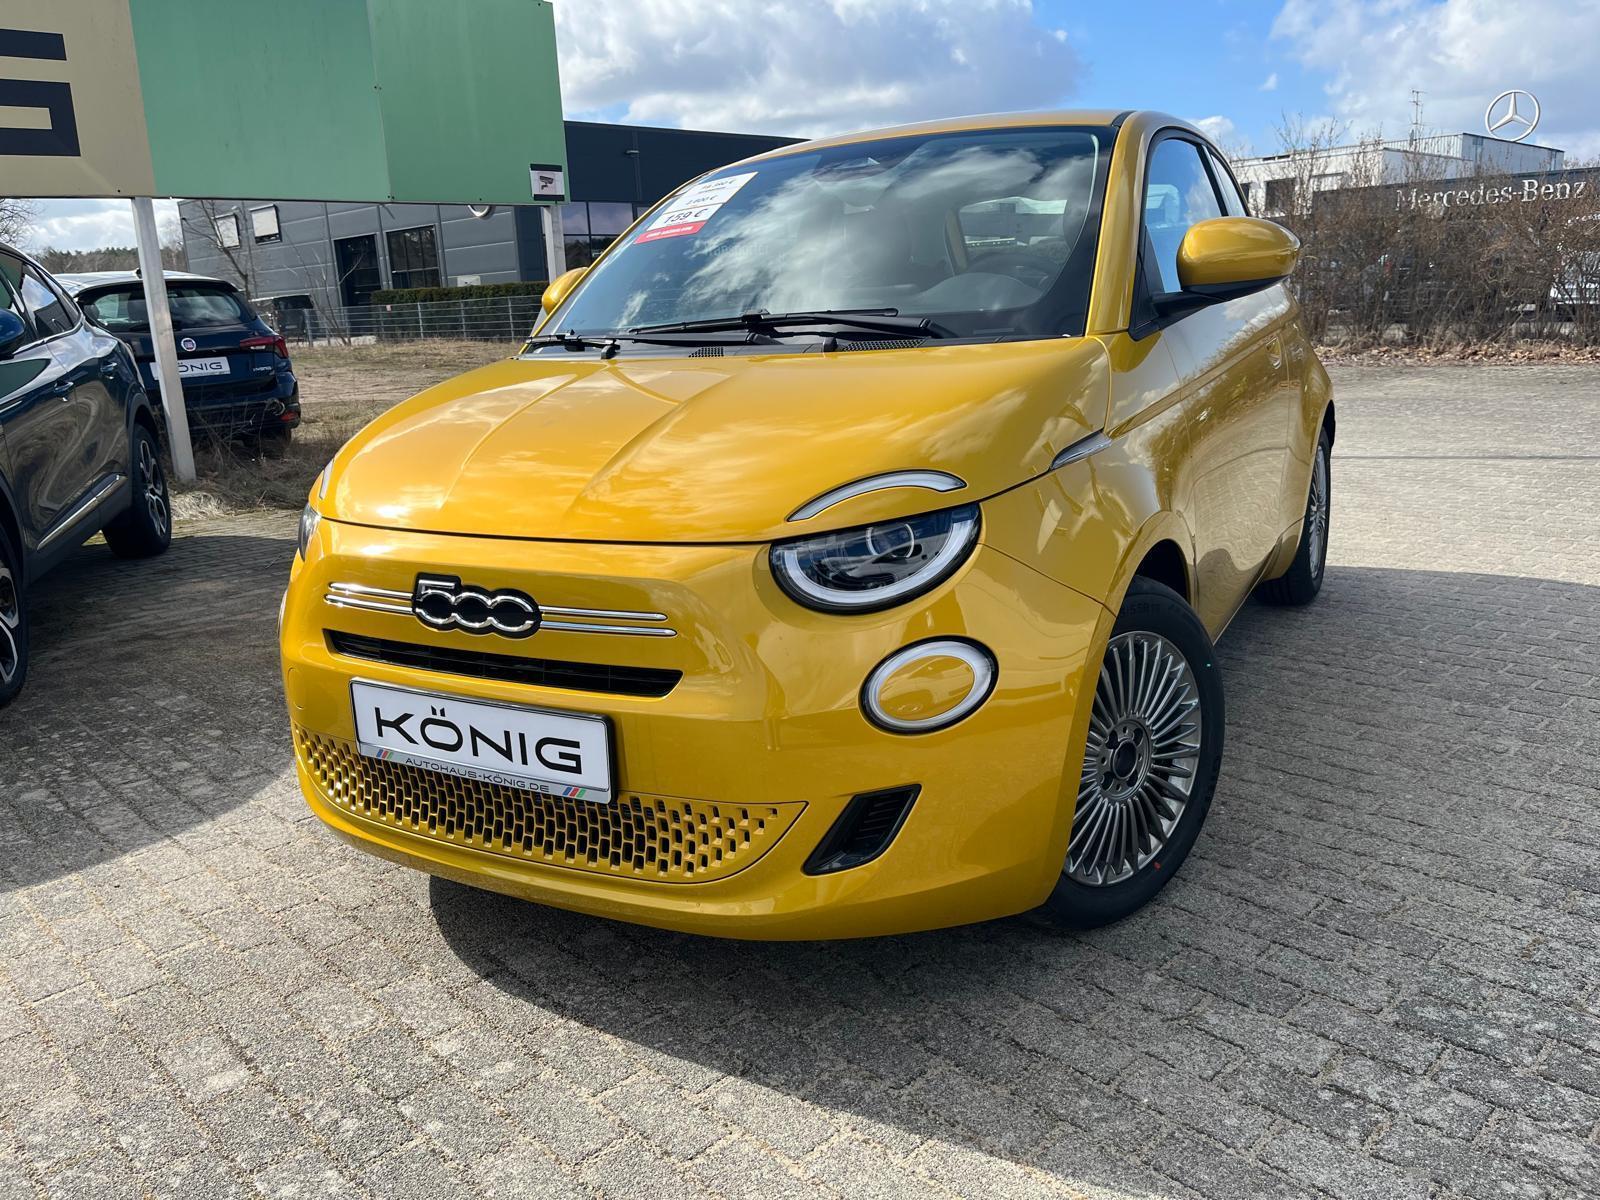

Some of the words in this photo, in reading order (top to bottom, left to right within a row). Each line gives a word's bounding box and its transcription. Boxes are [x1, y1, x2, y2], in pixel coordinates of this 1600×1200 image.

[1395, 179, 1587, 211] Mercedes-Benz
[663, 211, 692, 224] 159
[177, 361, 223, 373] ÖNIG
[413, 575, 539, 635] 500
[373, 704, 583, 775] KÖNIG
[404, 756, 550, 793] AUTOHAUS-KÖNIG.DE
